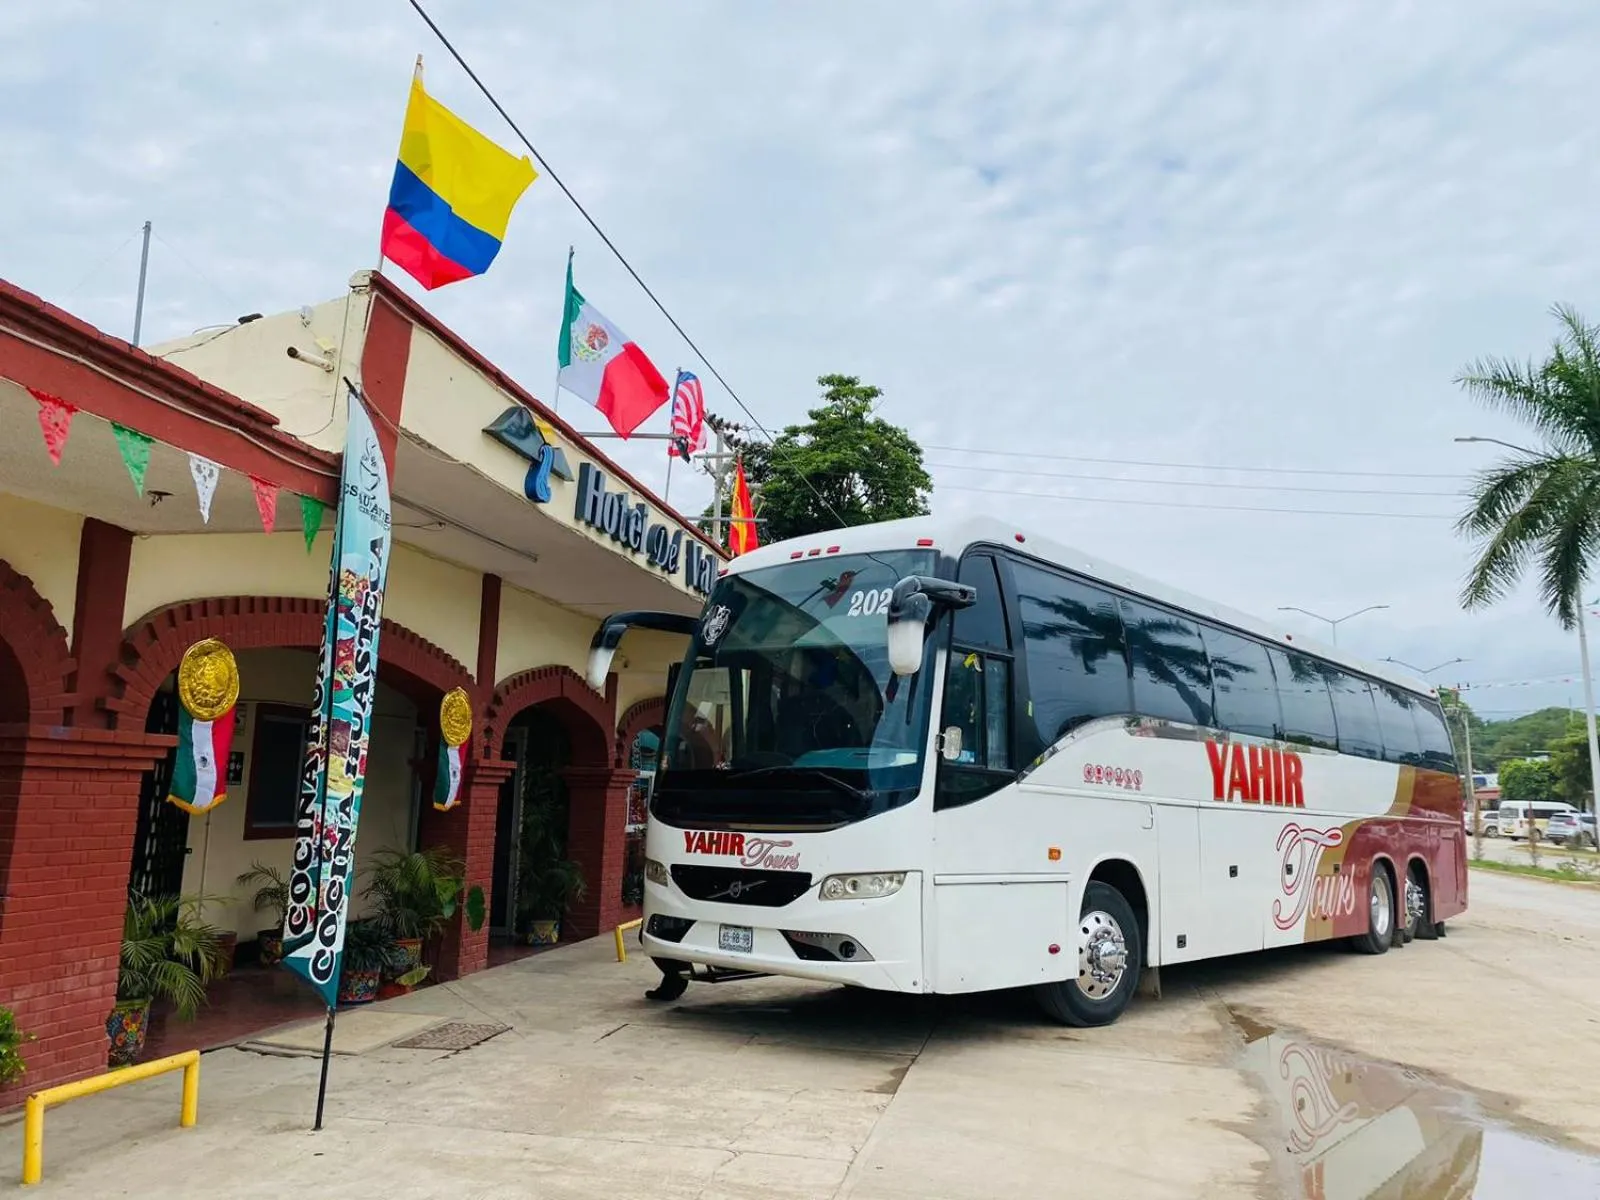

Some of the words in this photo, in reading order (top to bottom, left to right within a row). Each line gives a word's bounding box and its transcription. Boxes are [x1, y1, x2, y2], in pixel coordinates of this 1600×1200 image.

[575, 462, 649, 555] Hotel
[309, 788, 356, 984] COCINA
[343, 536, 386, 781] HUASTECA
[1205, 738, 1305, 809] YAHIR
[287, 751, 320, 938] COCINA
[683, 831, 746, 856] YAHIR
[740, 838, 801, 870] Tours
[1272, 822, 1356, 930] Tours
